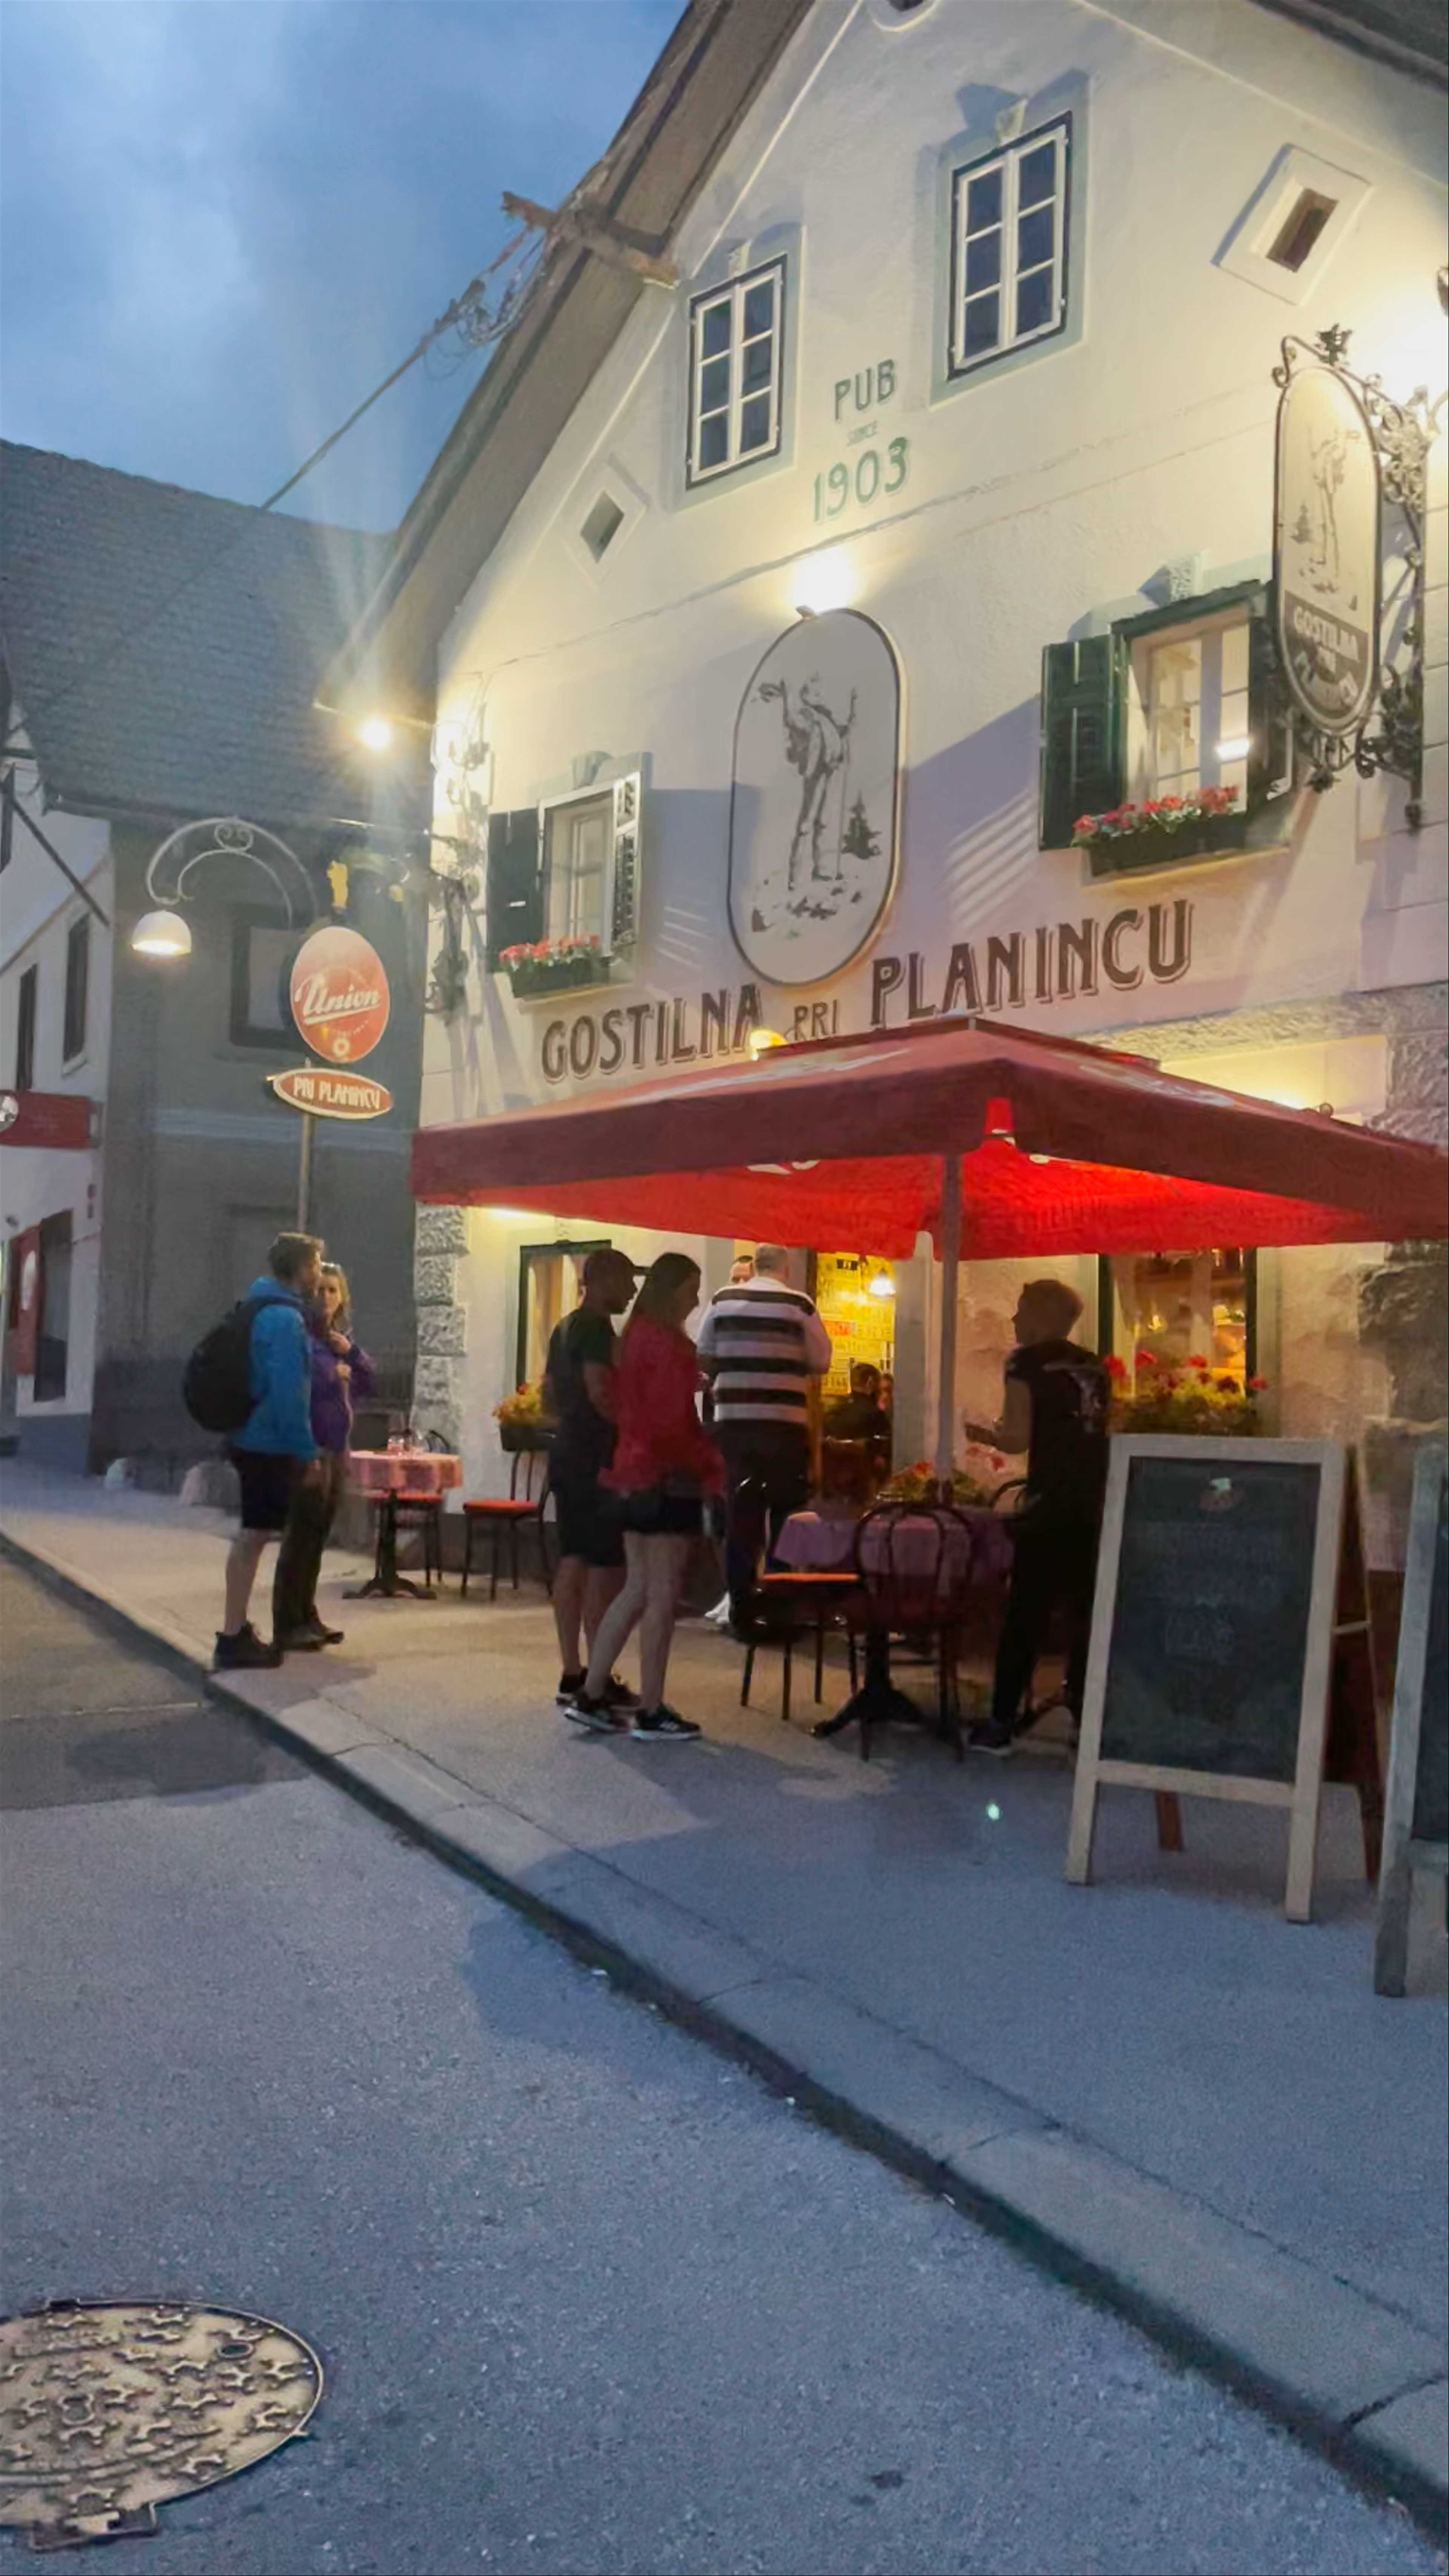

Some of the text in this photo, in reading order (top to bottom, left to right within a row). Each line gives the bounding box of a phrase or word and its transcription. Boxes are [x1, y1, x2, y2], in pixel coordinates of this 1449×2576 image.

[834, 358, 895, 421] PUB
[814, 437, 909, 522] 1903
[294, 974, 381, 1018] Union
[541, 899, 1194, 1085] GOSTILNA PRI PLANINCU
[293, 1076, 314, 1100] PRI
